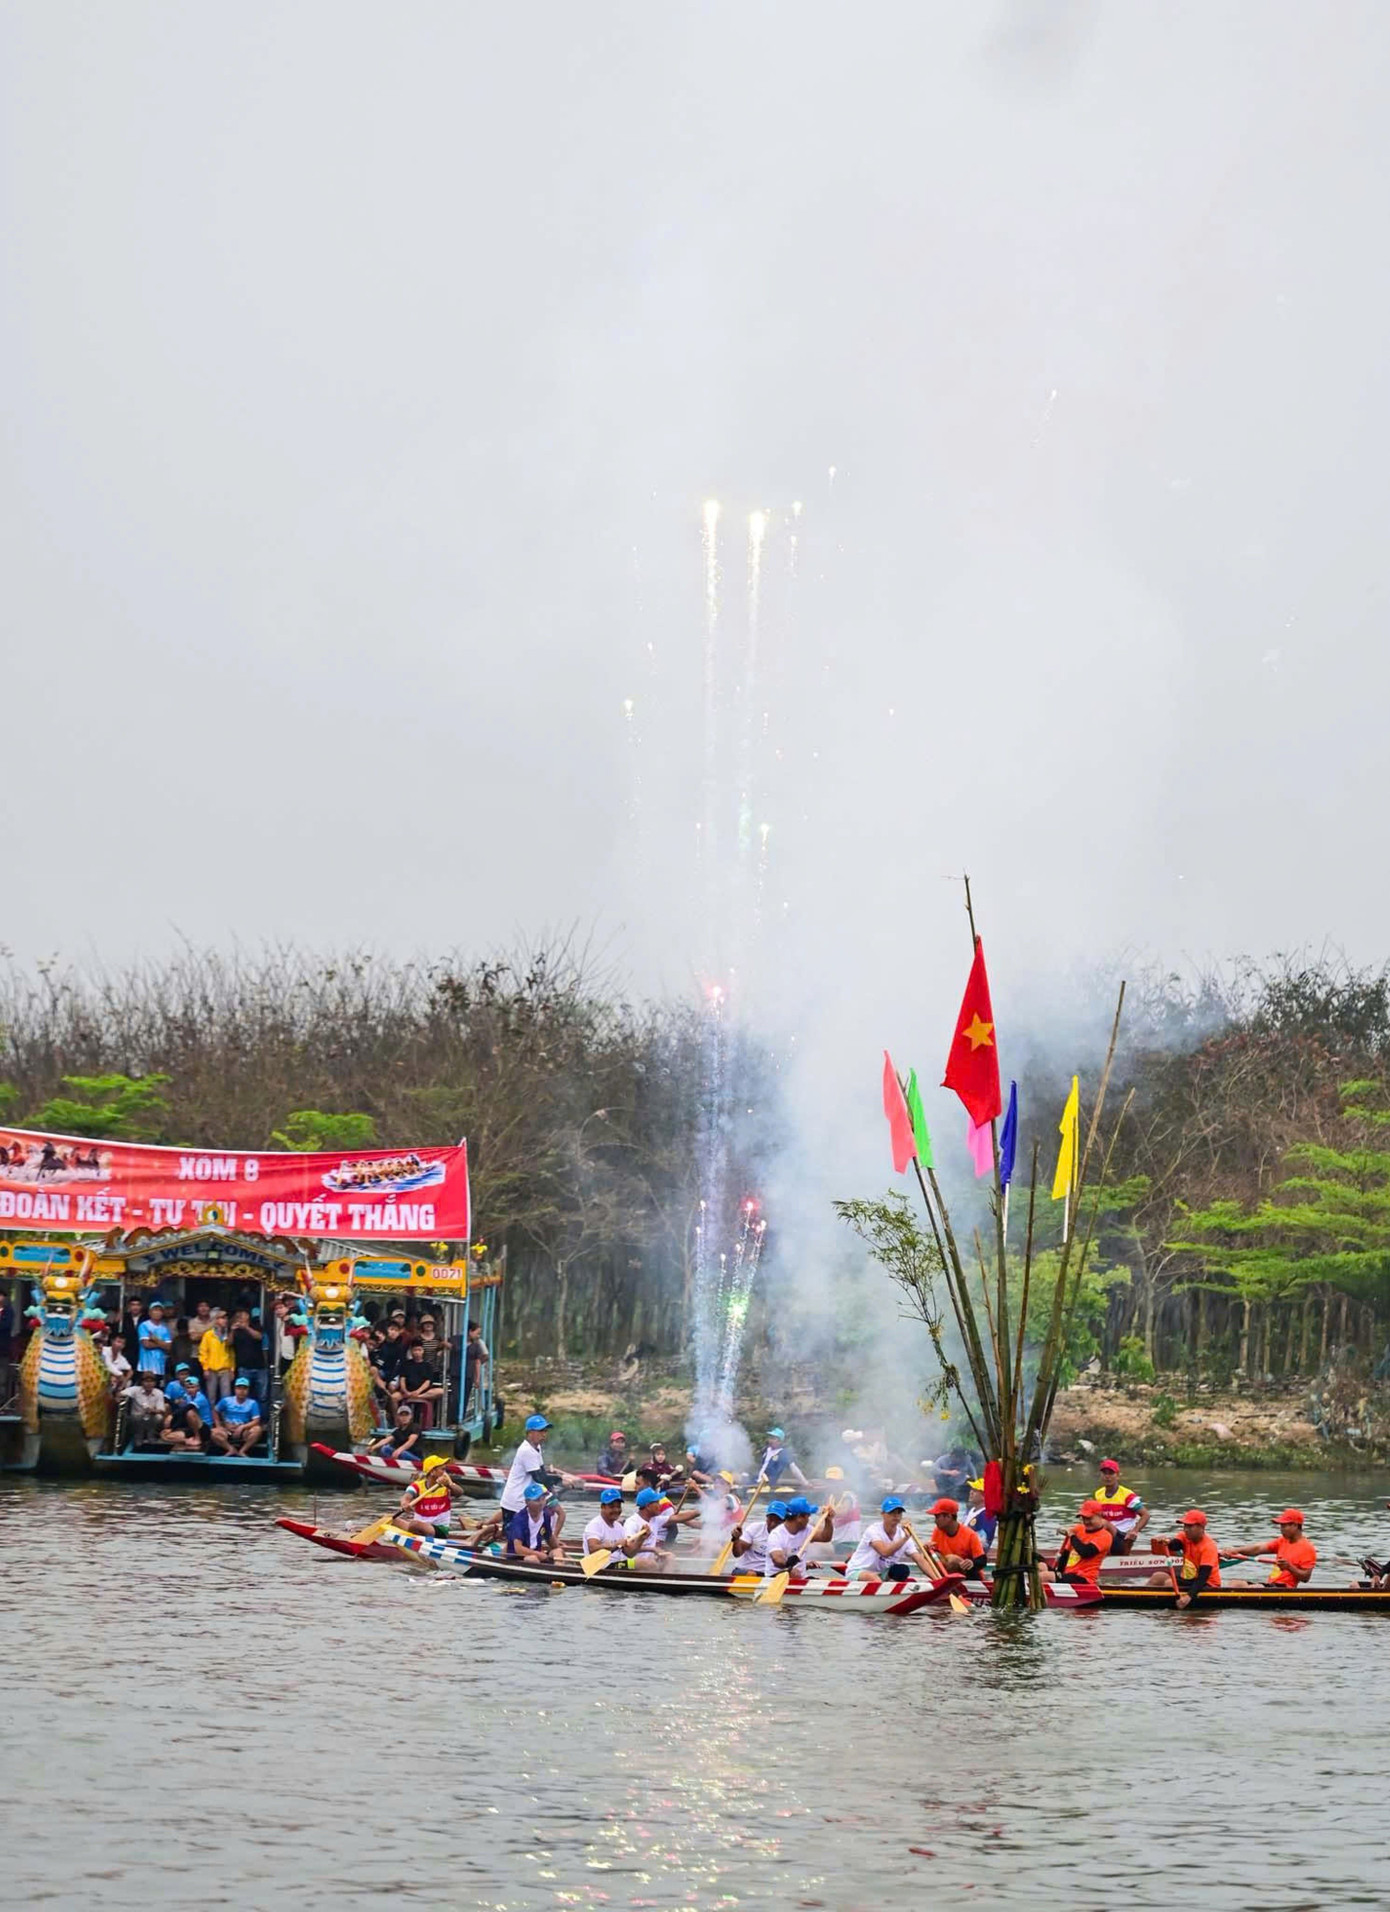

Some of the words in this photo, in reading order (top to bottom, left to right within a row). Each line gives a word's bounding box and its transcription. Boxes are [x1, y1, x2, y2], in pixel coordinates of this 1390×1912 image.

[244, 1158, 259, 1182] 8
[0, 1186, 70, 1220] ĐOÀN
[76, 1187, 126, 1223] KẾT
[191, 1200, 237, 1227] TN
[260, 1193, 342, 1233] QUYẾT
[348, 1194, 435, 1231] THẮNG
[432, 1268, 461, 1279] 0071
